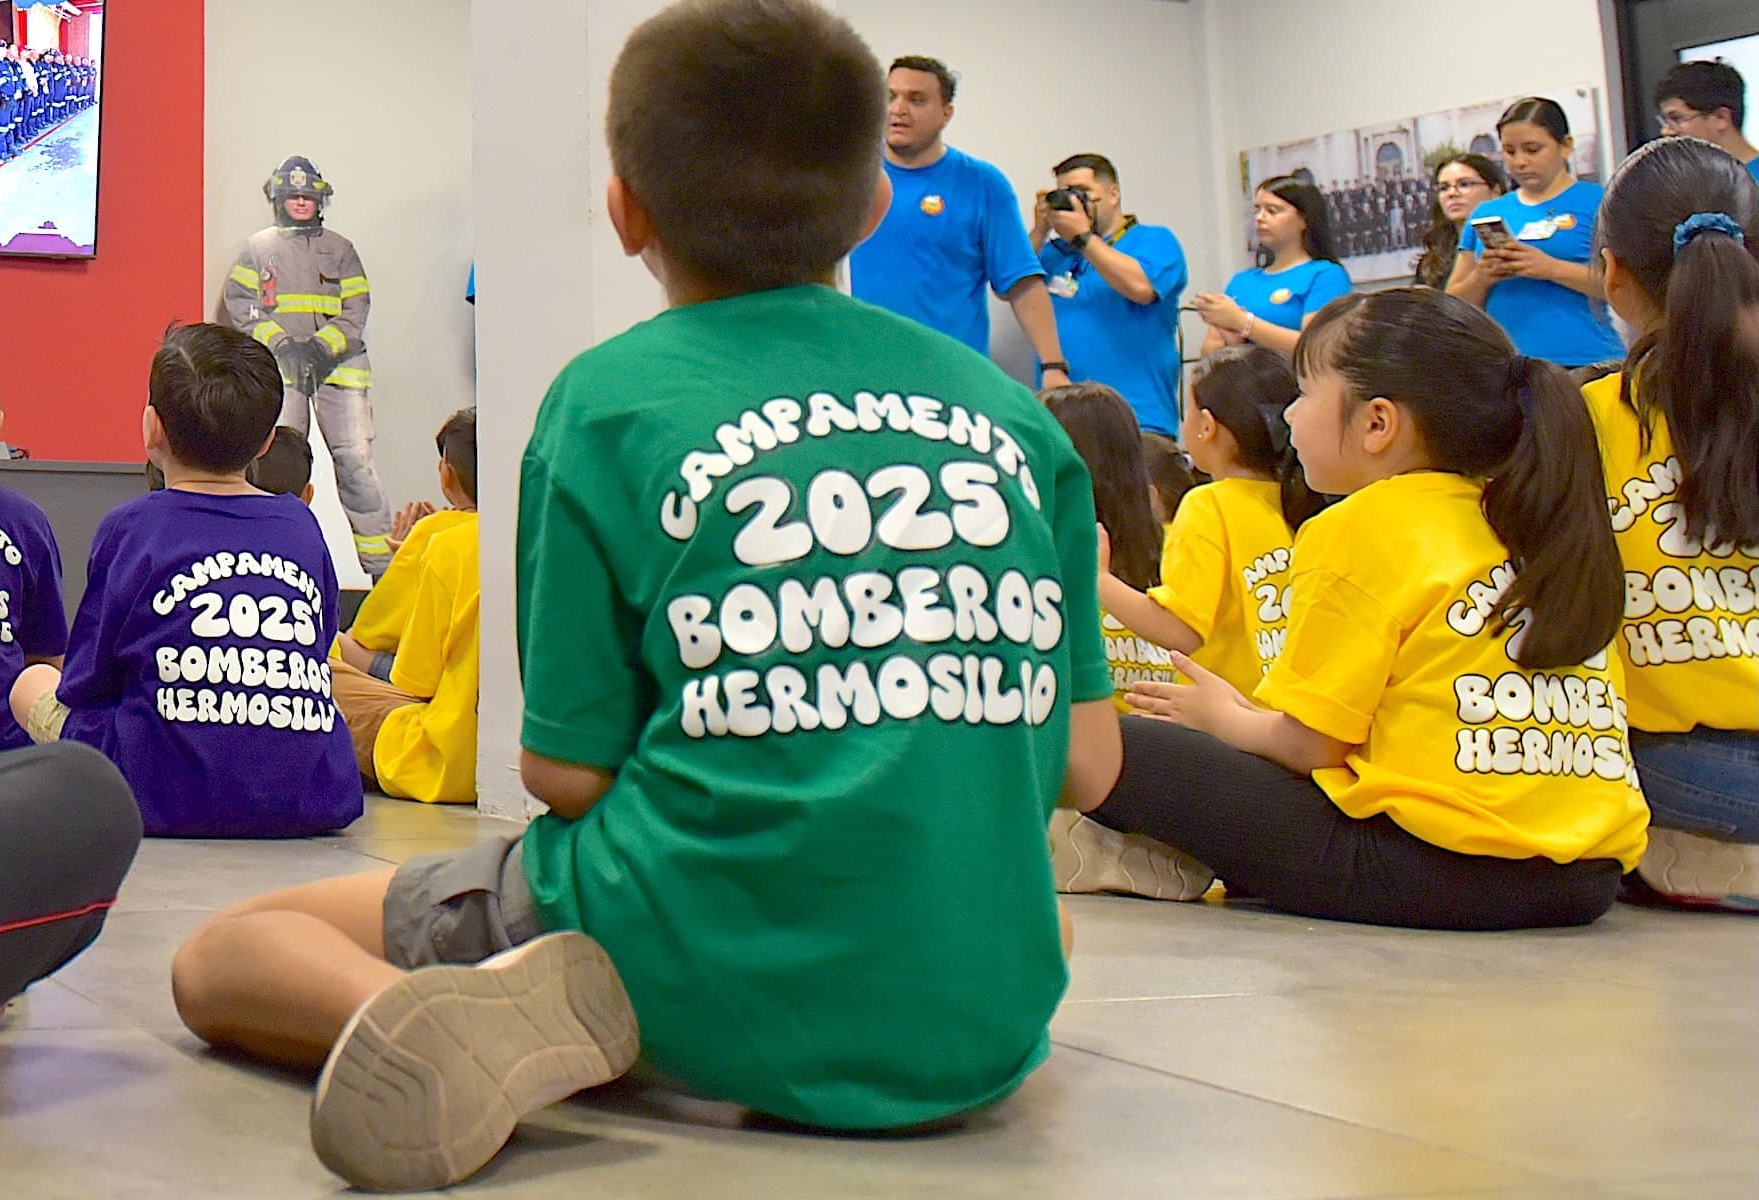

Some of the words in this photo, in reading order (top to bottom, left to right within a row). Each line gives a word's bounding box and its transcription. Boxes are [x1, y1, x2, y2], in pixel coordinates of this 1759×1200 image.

[660, 390, 1042, 541] CAMPAMENTO
[1608, 455, 1684, 533] CAM
[724, 460, 1011, 567] 2025
[152, 551, 324, 633] CAMPAMENT
[189, 592, 317, 646] 2025
[667, 563, 1064, 670] BOMBEROS
[1446, 560, 1519, 637] CAM
[1623, 565, 1759, 615] BOMB
[155, 645, 332, 700] BOMBEROS
[1622, 615, 1759, 668] HERM
[1453, 671, 1629, 733] BOMBE
[1454, 726, 1641, 792] HERMOS
